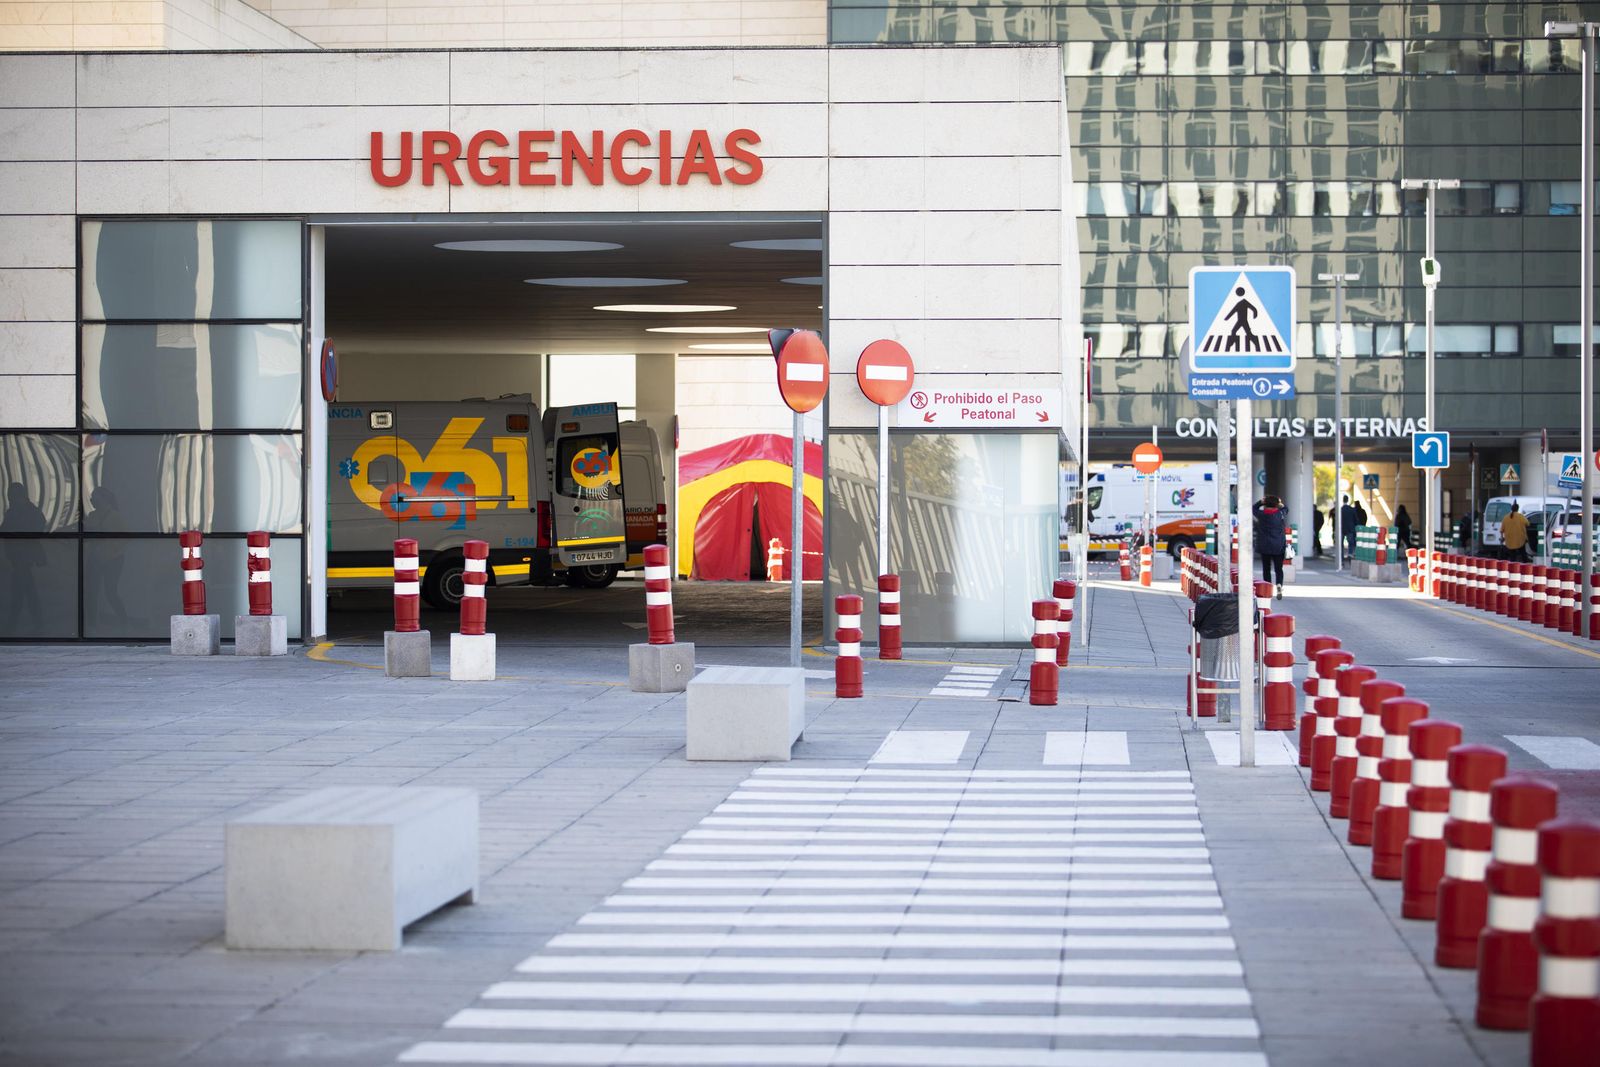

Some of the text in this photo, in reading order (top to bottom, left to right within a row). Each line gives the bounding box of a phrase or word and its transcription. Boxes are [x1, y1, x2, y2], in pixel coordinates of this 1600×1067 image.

[370, 129, 764, 187] URGENCIAS
[1192, 378, 1253, 386] Entrada Peatonal
[934, 392, 1042, 404] Prohibido el Paso
[1192, 388, 1227, 396] Consultas
[961, 408, 1015, 420] Peatonal
[1175, 417, 1428, 438] CONSLTAS EXTERNAS
[350, 417, 529, 511] 061
